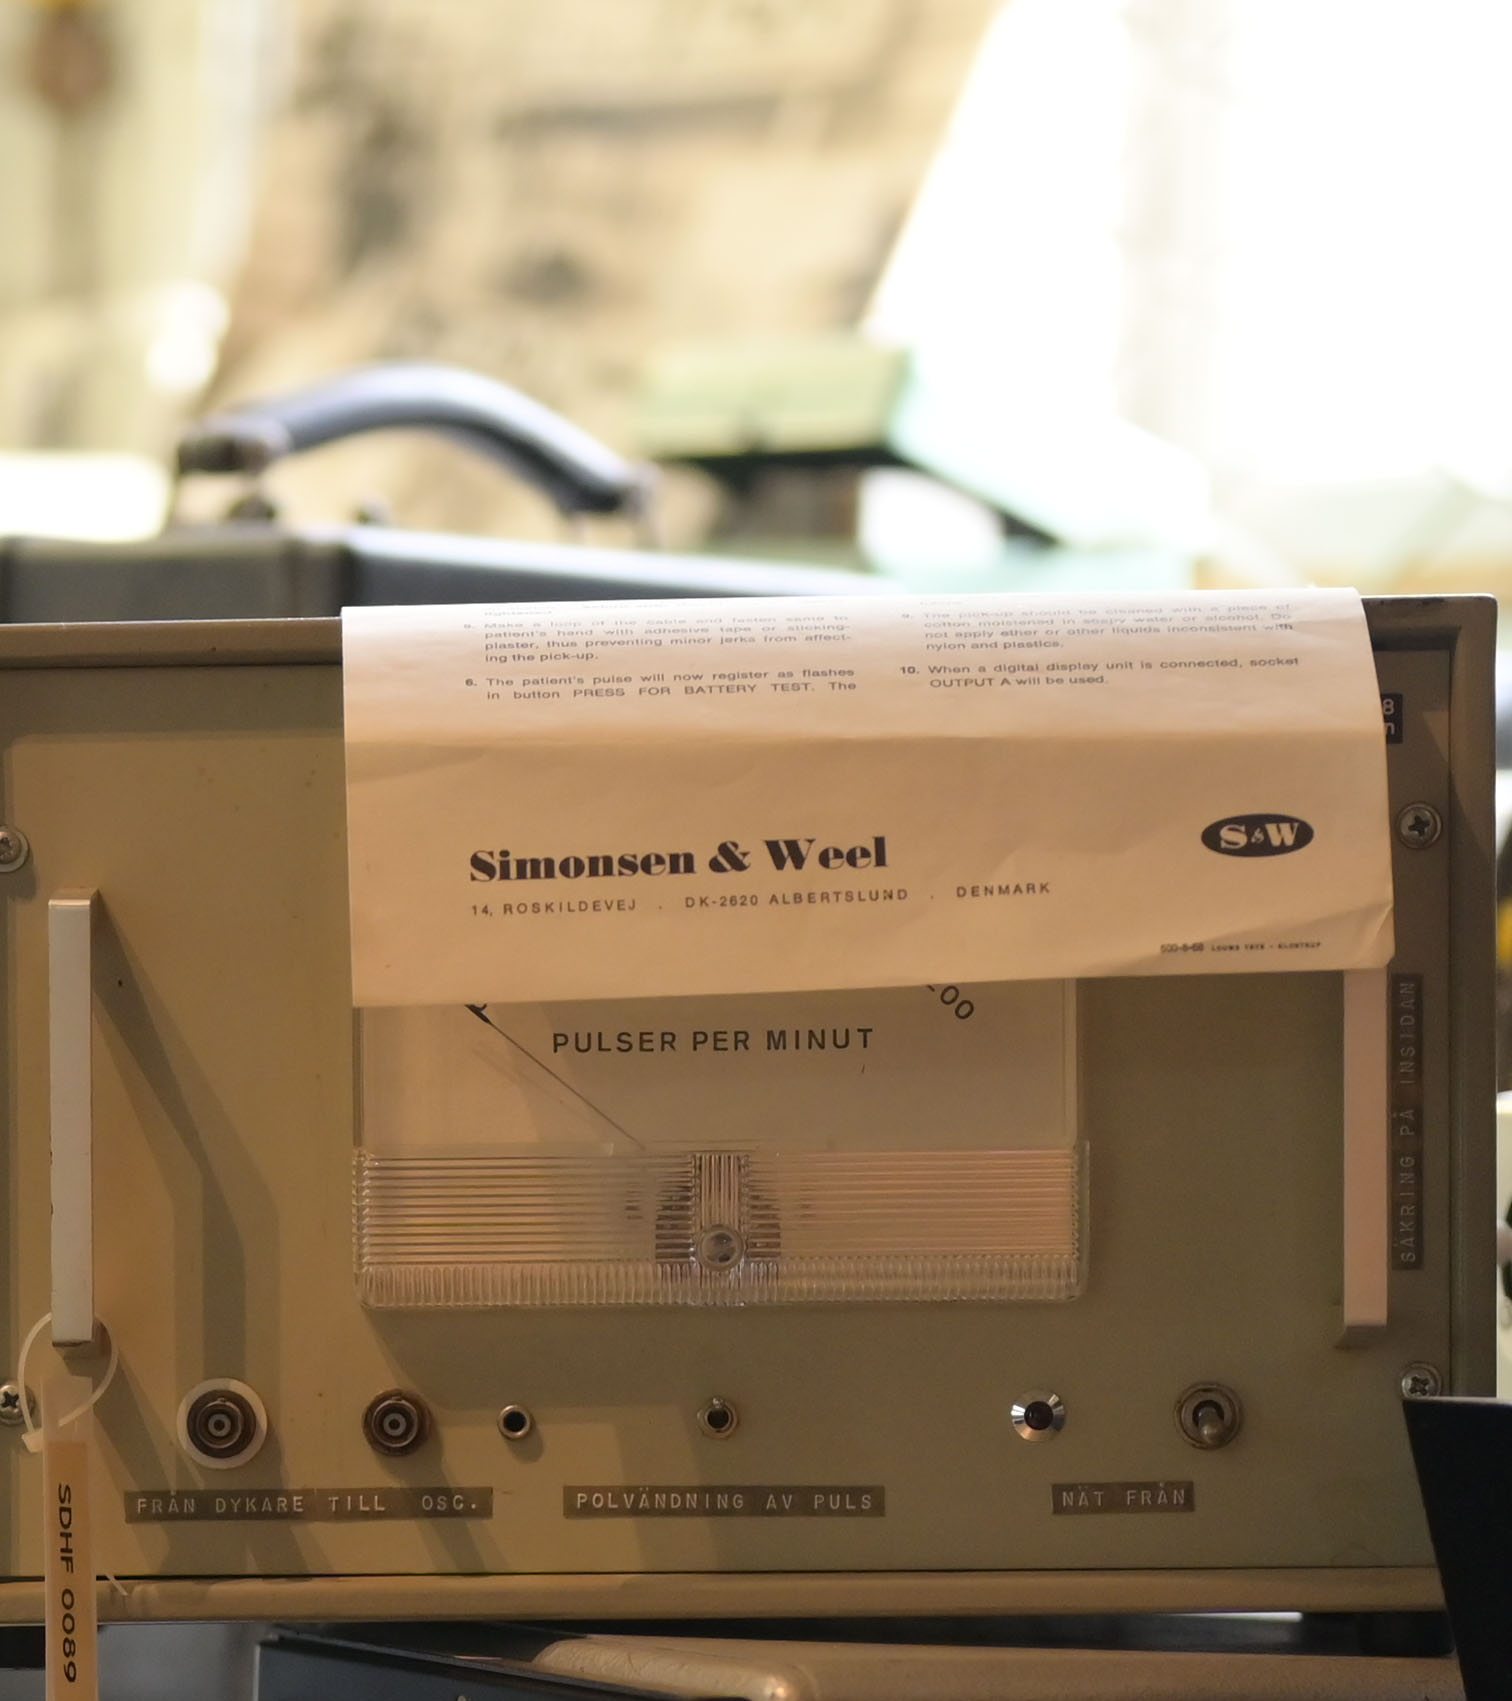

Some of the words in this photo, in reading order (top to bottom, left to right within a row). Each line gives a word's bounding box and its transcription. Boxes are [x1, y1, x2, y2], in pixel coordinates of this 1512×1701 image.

[485, 641, 540, 651] plaster,
[547, 640, 577, 648] thus
[585, 637, 663, 648] preventing
[670, 636, 712, 645] minor
[764, 634, 797, 642] from
[925, 630, 948, 639] not
[955, 628, 994, 640] apply
[1067, 626, 1105, 636] other
[1111, 625, 1162, 637] liquids
[485, 653, 508, 664] ing
[512, 652, 535, 662] the
[539, 651, 599, 663] pick-up.
[926, 640, 967, 653] nylon
[970, 640, 999, 650] and
[1003, 638, 1065, 651] plastics.
[900, 665, 921, 675] 10.
[927, 663, 971, 674] When
[993, 662, 1040, 675] digital
[1046, 660, 1100, 674] display
[1106, 660, 1134, 670] unit
[1141, 660, 1154, 670] is
[1159, 658, 1244, 670] connected,
[1249, 656, 1299, 667] socket
[486, 690, 501, 700] in
[513, 688, 561, 700] button
[573, 687, 626, 698] PRESS
[638, 686, 672, 696] FOR
[684, 684, 758, 695] BATTERY
[770, 682, 816, 693] TEST.
[828, 680, 858, 691] The
[487, 678, 514, 687] The
[522, 676, 585, 688] patient's
[592, 675, 632, 686] pulse
[639, 673, 666, 682] will
[712, 670, 769, 682] register
[802, 668, 856, 678] flashes
[929, 677, 996, 688] OUTPUT
[1000, 676, 1013, 687] A
[1015, 675, 1041, 686] will
[1045, 675, 1065, 685] be
[1069, 674, 1110, 685] used.
[1218, 822, 1300, 850] S&W
[469, 847, 697, 883] Simonsen
[708, 841, 752, 873] &
[764, 836, 889, 872] Weel
[473, 904, 494, 916] 14,
[503, 898, 637, 915] ROSKILDEVEJ
[685, 894, 759, 909] DK-2620
[769, 888, 909, 906] ALBERTSLUND
[956, 882, 1051, 899] DENMARK
[552, 1031, 678, 1053] PULSER
[692, 1030, 750, 1051] PER
[766, 1027, 874, 1051] MINUT
[1400, 981, 1415, 1085] INSIDAN
[1392, 1155, 1416, 1263] SÄKRING
[137, 1490, 195, 1514] FRÅN
[215, 1496, 305, 1513] DYKARE
[328, 1495, 385, 1513] TILL
[421, 1494, 478, 1512] OSC.
[576, 1487, 744, 1510] POLVÄNDNING
[766, 1494, 793, 1510] AV
[813, 1494, 873, 1510] PULS
[1062, 1486, 1104, 1507] NÄT
[1127, 1481, 1185, 1506] FRÅN
[58, 1484, 74, 1574] SDHF
[61, 1588, 77, 1683] 0089
